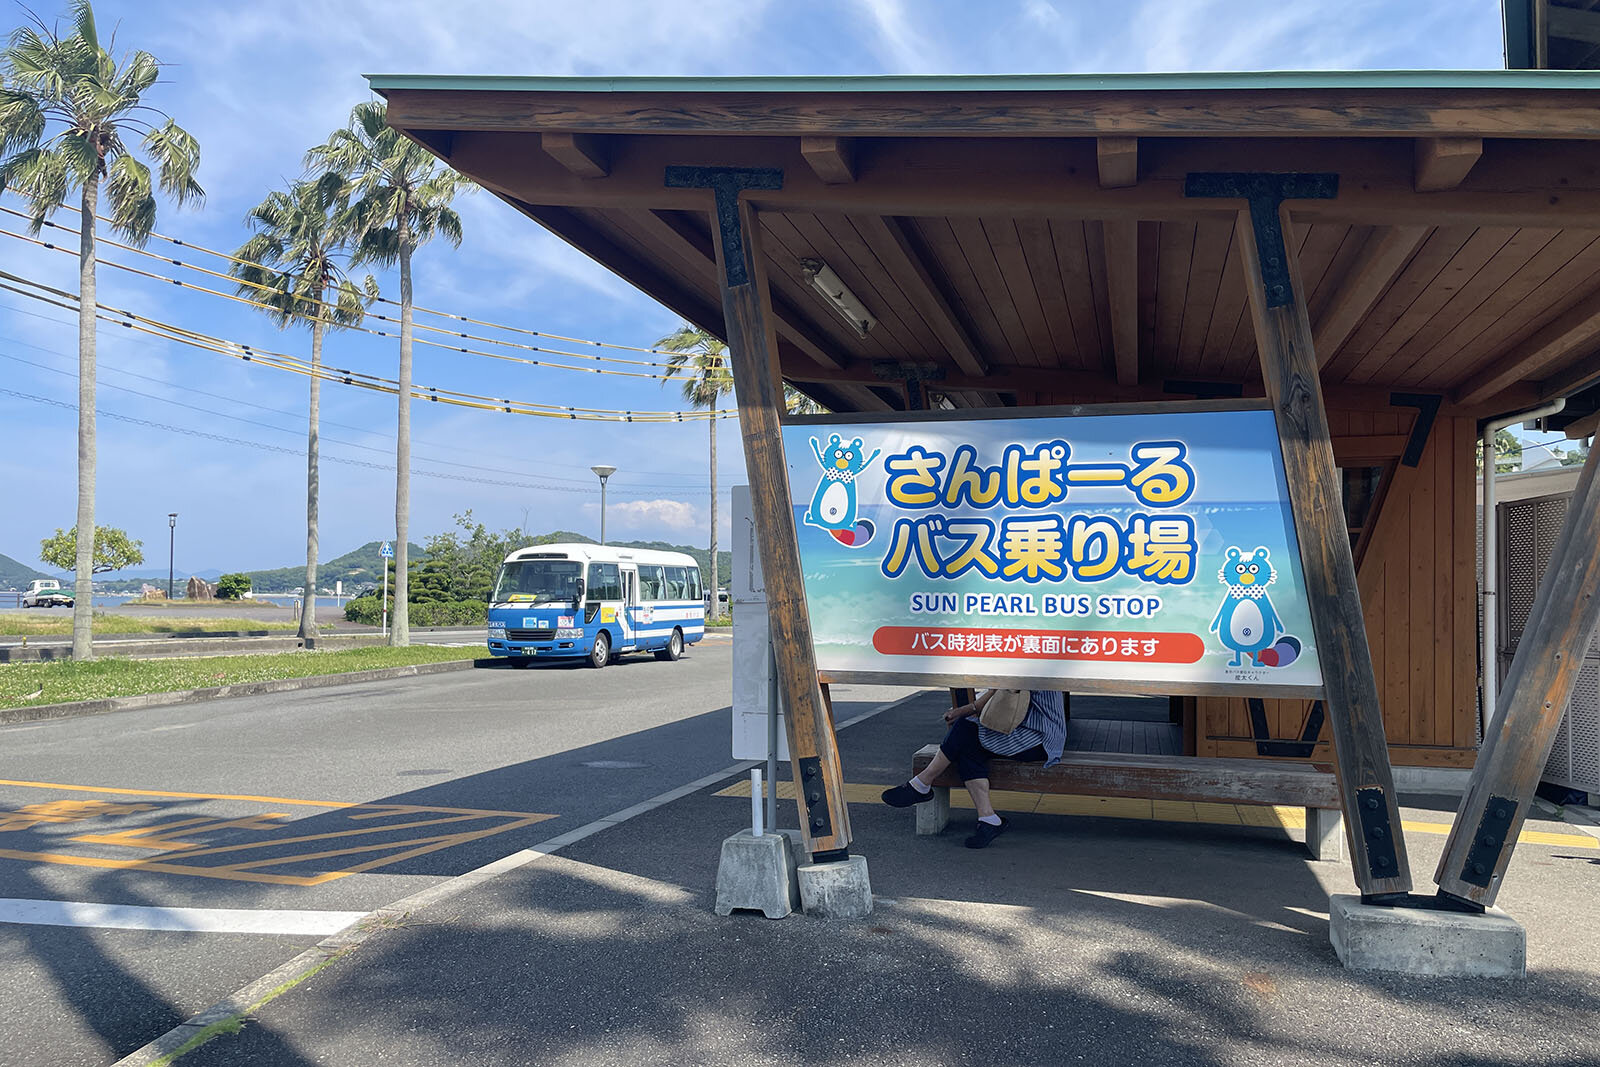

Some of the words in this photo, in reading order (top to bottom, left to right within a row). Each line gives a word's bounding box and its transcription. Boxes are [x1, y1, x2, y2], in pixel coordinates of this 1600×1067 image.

[885, 441, 1195, 509] さんぱーる
[883, 515, 1197, 583] バス乗り場
[911, 594, 957, 612] SUN
[966, 595, 1036, 614] PEARL
[1045, 597, 1090, 615] BUS
[1098, 598, 1160, 616] STOP
[911, 632, 1160, 657] バス時刻表が裏面にあります
